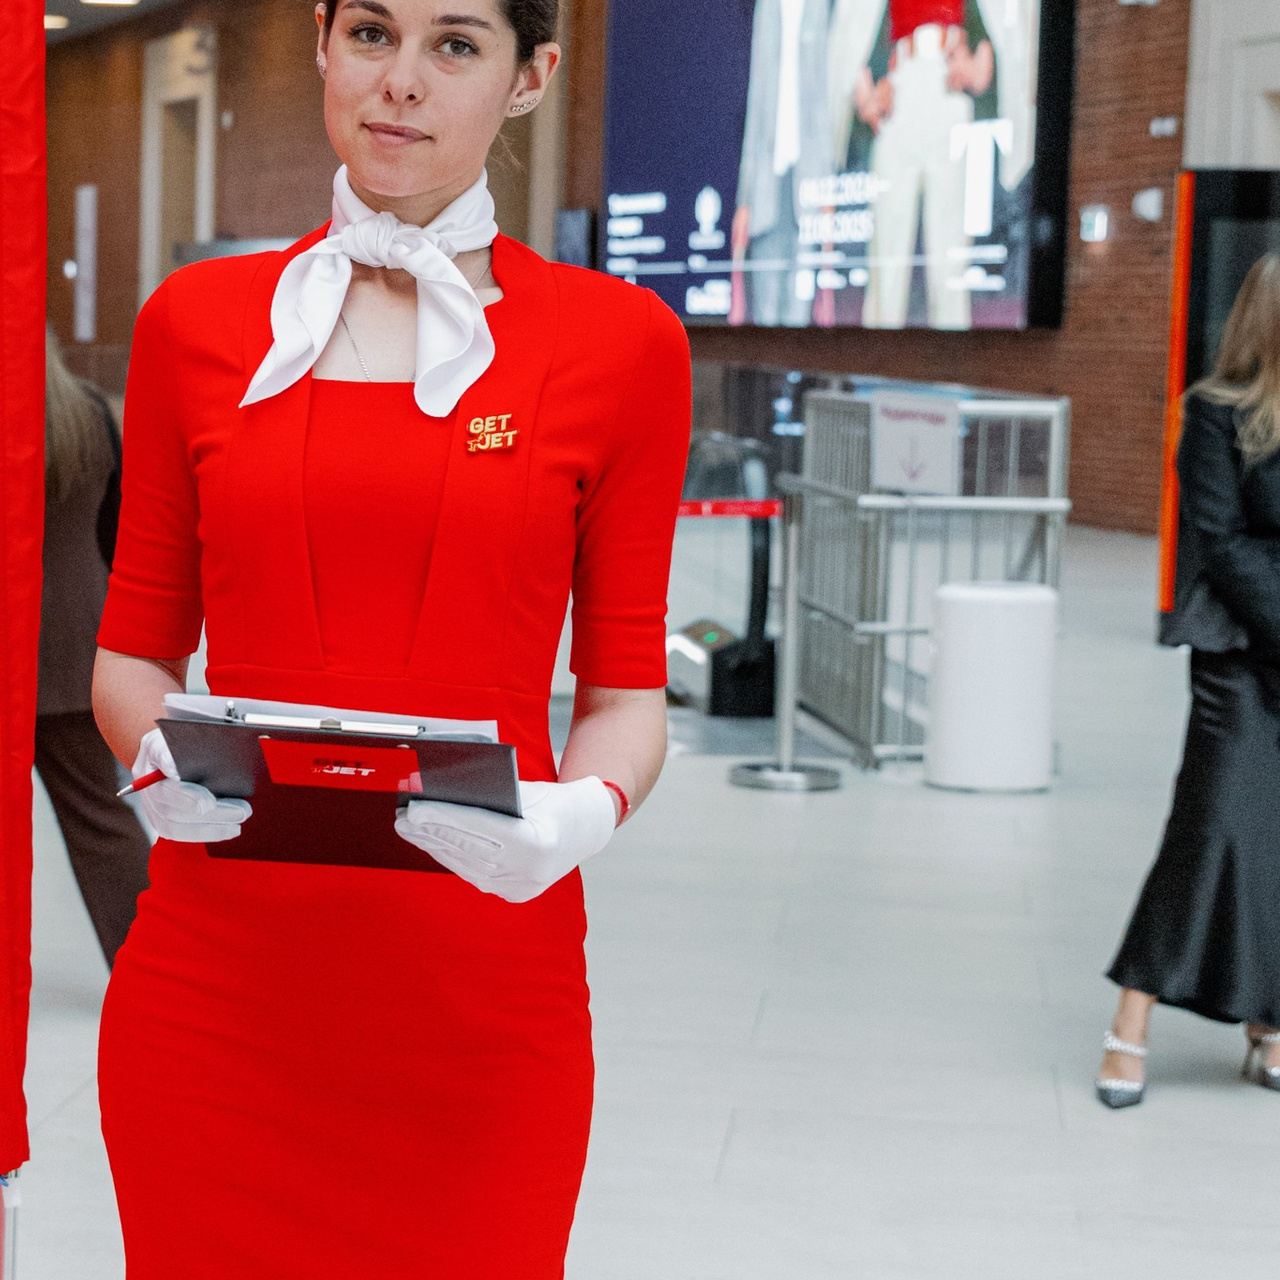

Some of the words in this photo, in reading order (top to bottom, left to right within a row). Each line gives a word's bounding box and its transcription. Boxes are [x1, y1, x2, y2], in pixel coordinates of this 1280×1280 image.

[469, 413, 512, 434] GET
[477, 429, 518, 450] JET
[322, 765, 376, 776] JET
